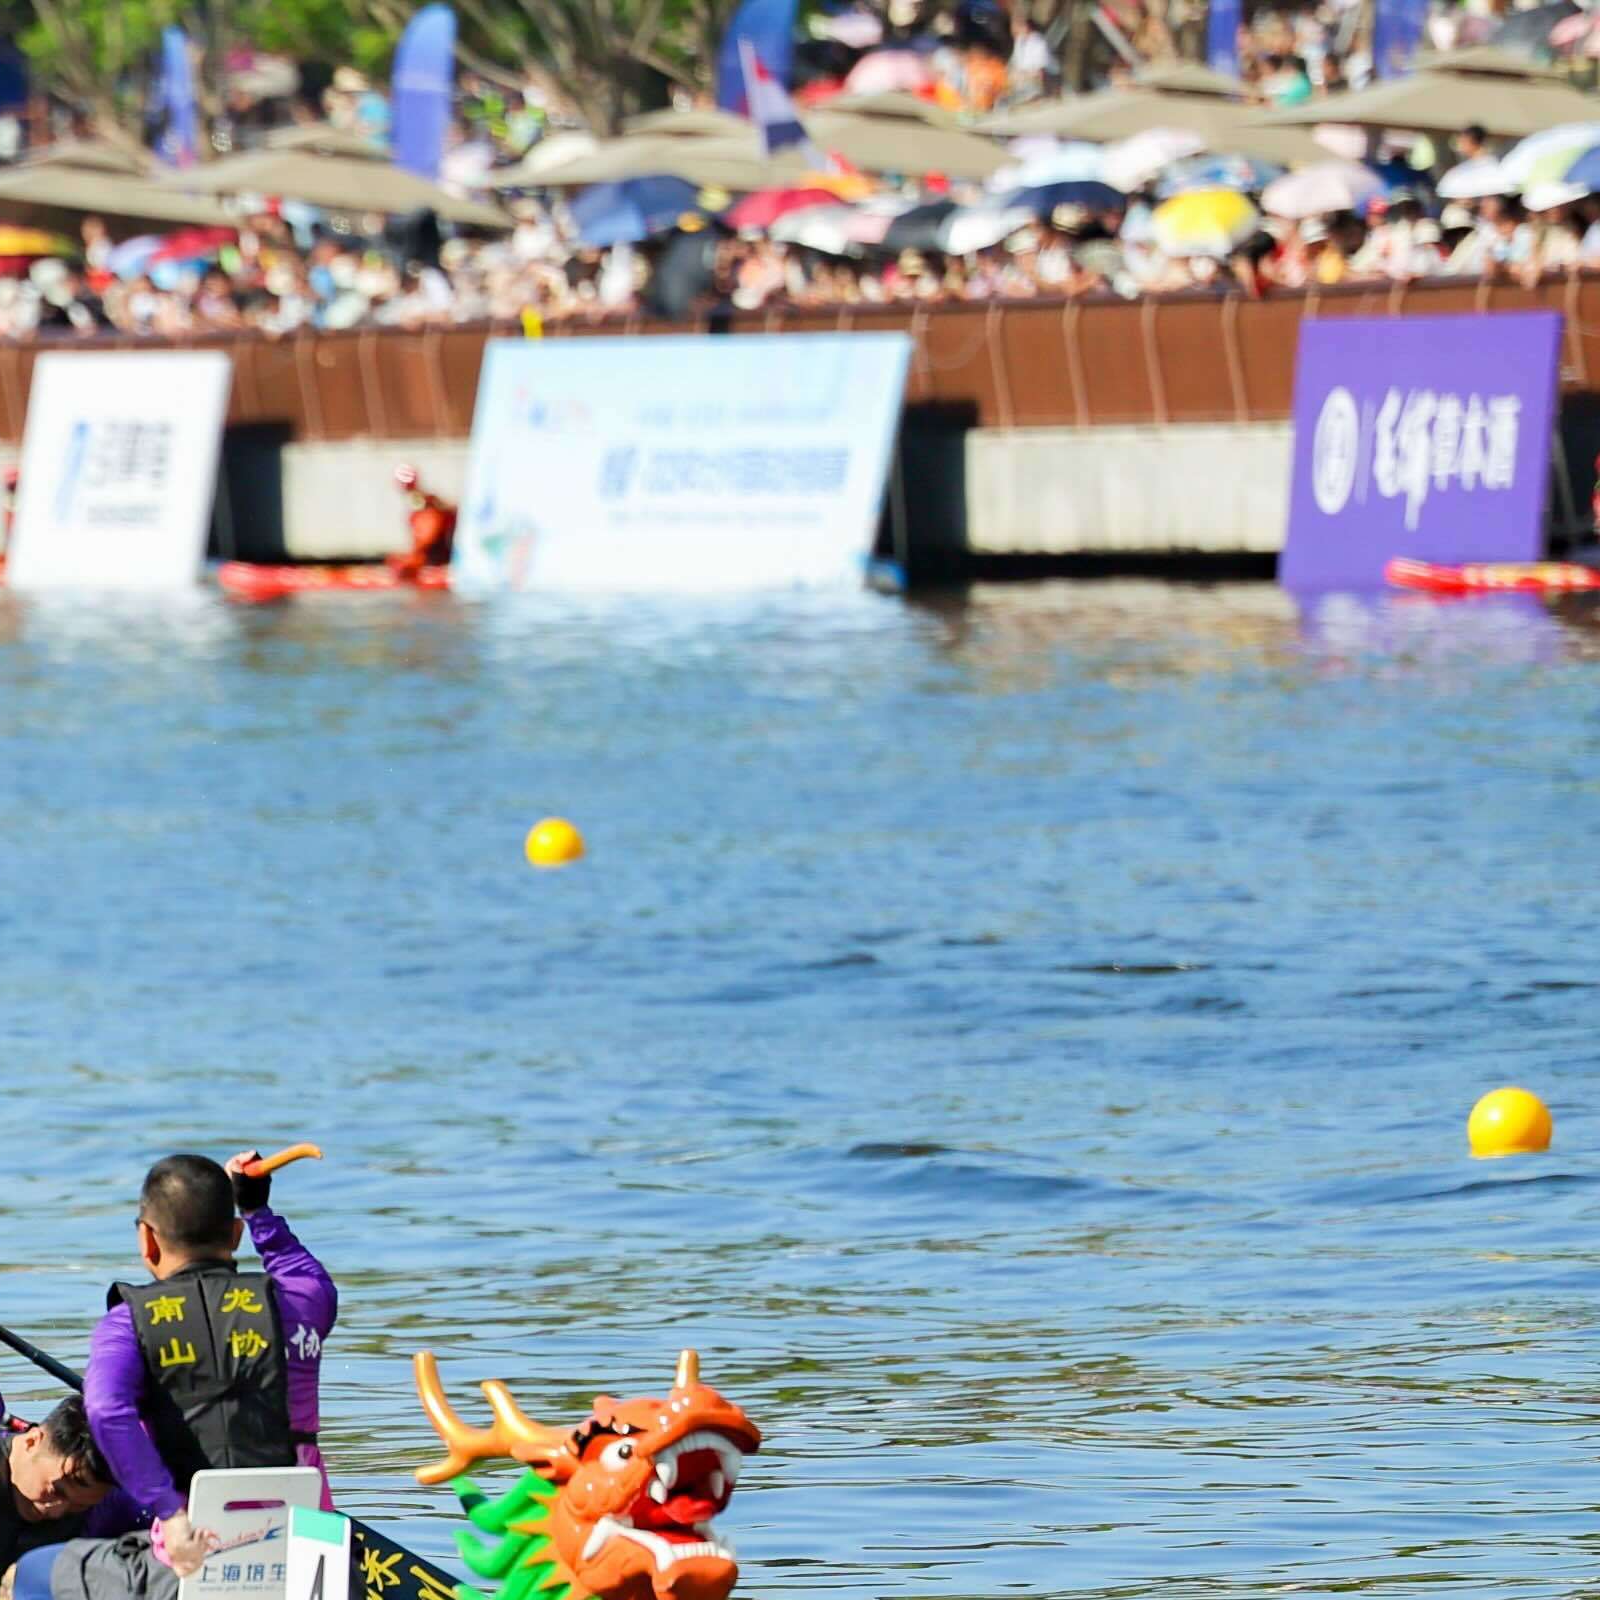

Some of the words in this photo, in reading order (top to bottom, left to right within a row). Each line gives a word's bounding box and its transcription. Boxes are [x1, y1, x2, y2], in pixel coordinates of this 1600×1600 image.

[144, 1294, 197, 1369] 南山
[220, 1286, 270, 1360] 龙协
[284, 1322, 323, 1362] 协
